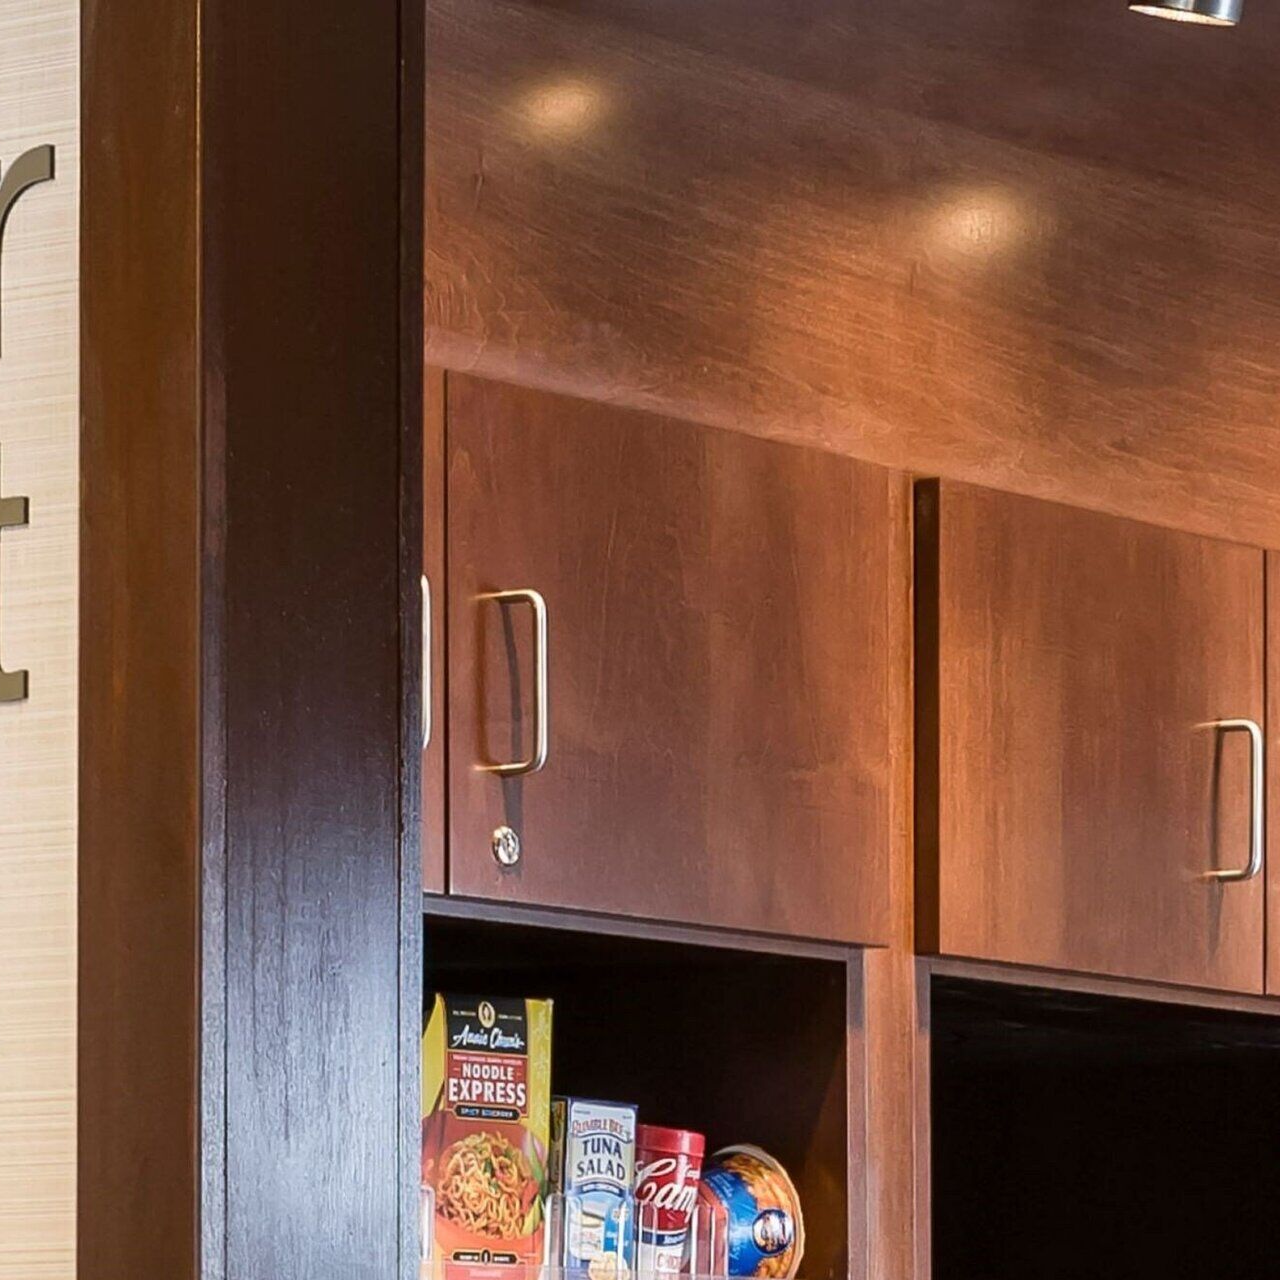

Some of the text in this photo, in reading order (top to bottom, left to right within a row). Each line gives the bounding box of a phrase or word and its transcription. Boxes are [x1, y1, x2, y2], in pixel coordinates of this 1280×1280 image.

[462, 1063, 515, 1081] NOODLE
[448, 1078, 527, 1107] EXPRESS
[582, 1137, 623, 1159] TUNA
[577, 1158, 626, 1180] SALAD
